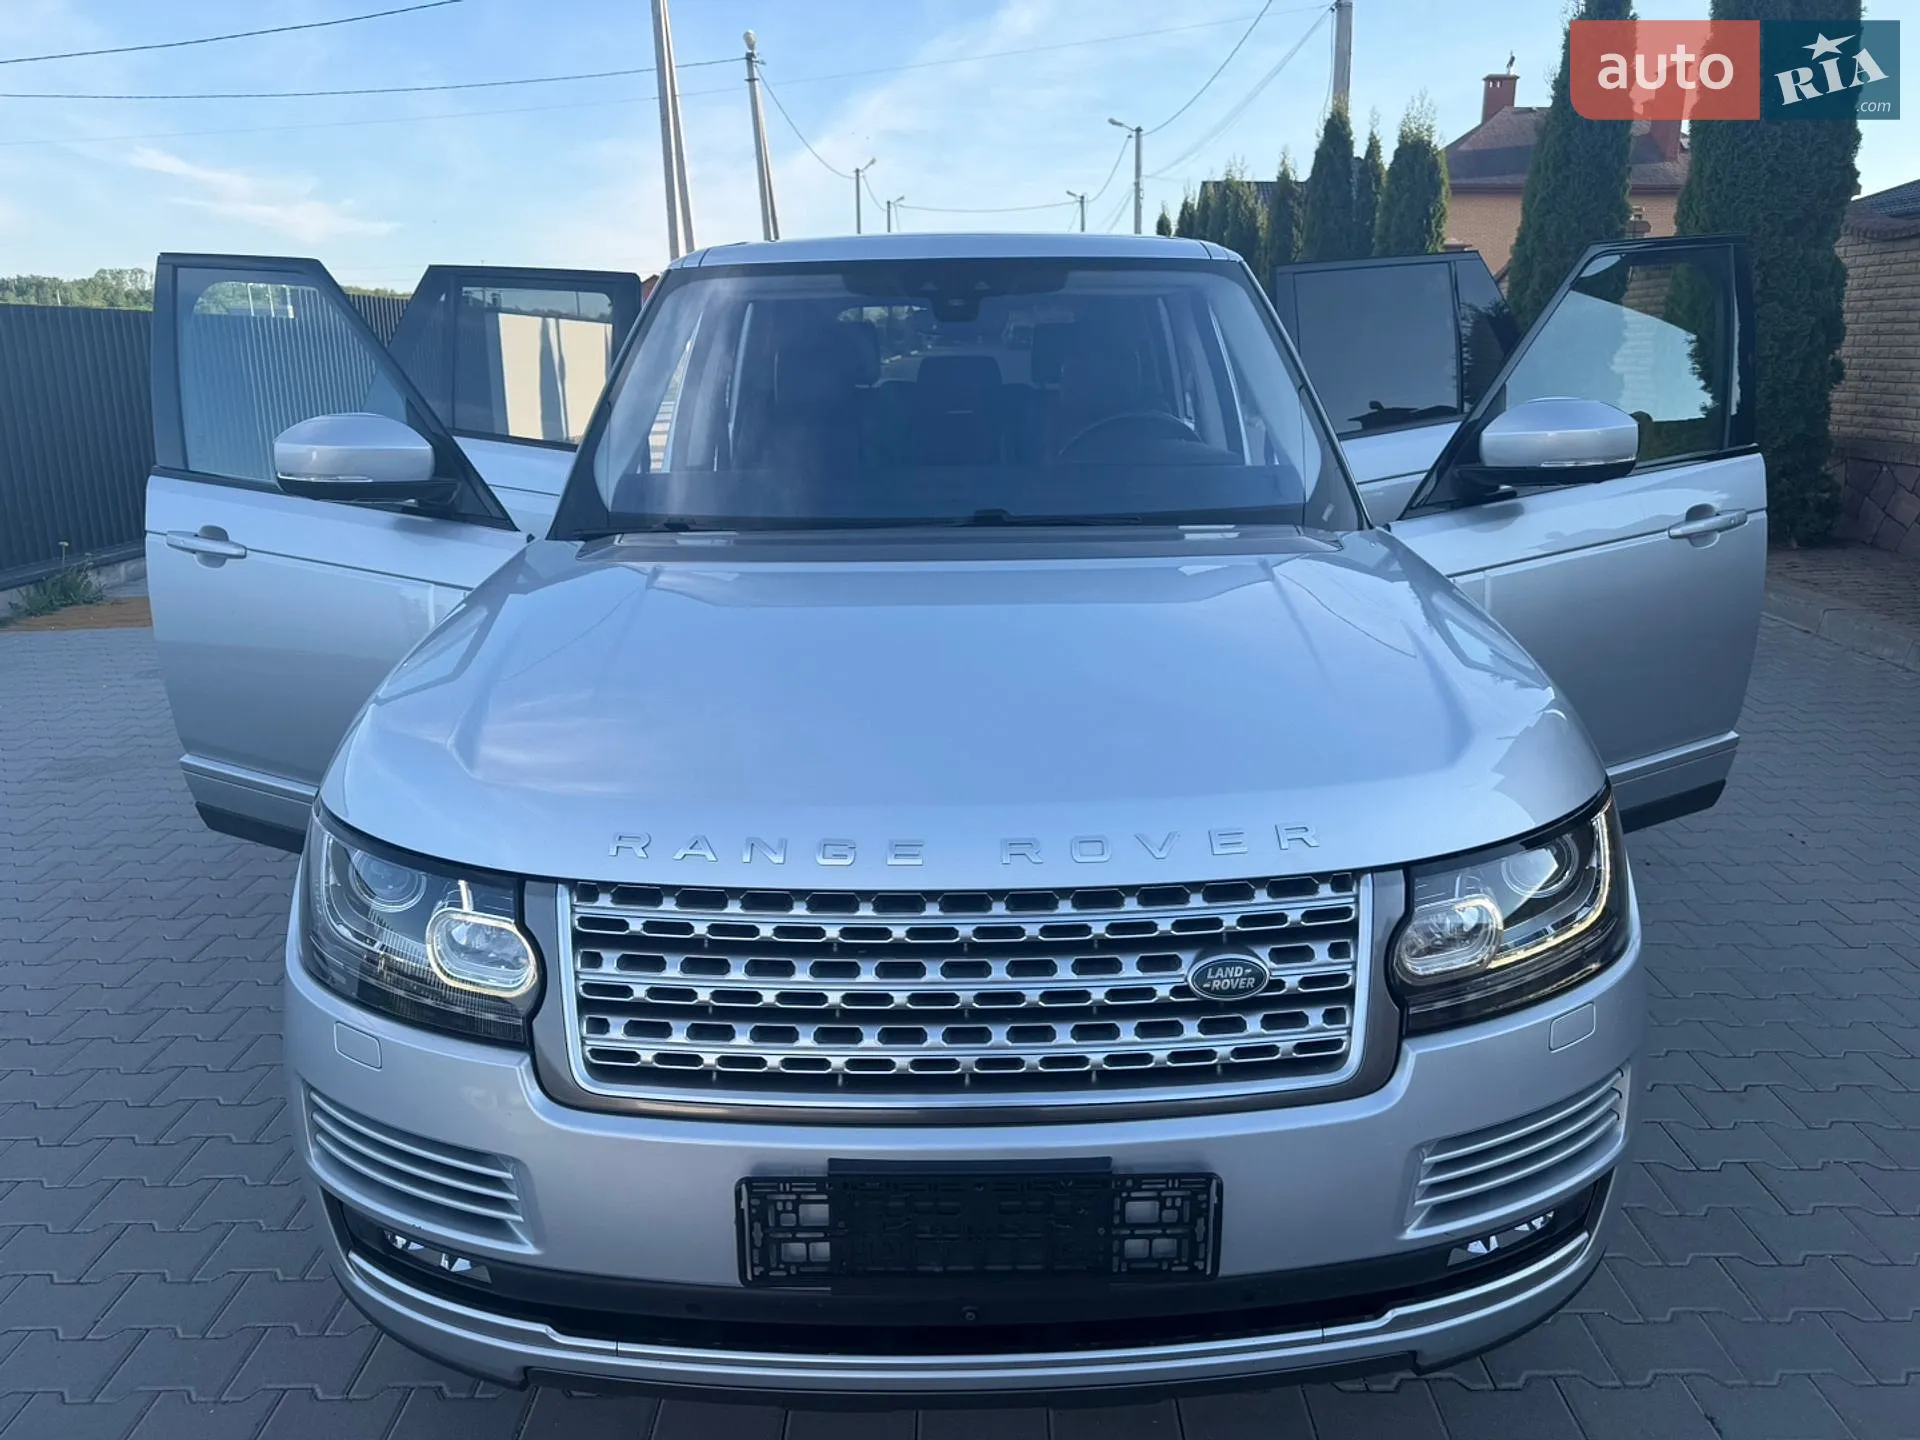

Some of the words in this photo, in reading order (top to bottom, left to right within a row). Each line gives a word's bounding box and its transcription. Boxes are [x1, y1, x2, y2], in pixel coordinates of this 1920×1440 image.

[608, 831, 925, 867] RANGE
[1000, 823, 1320, 865] ROVER
[1206, 966, 1244, 979] LAND
[1210, 977, 1255, 991] ROVER
